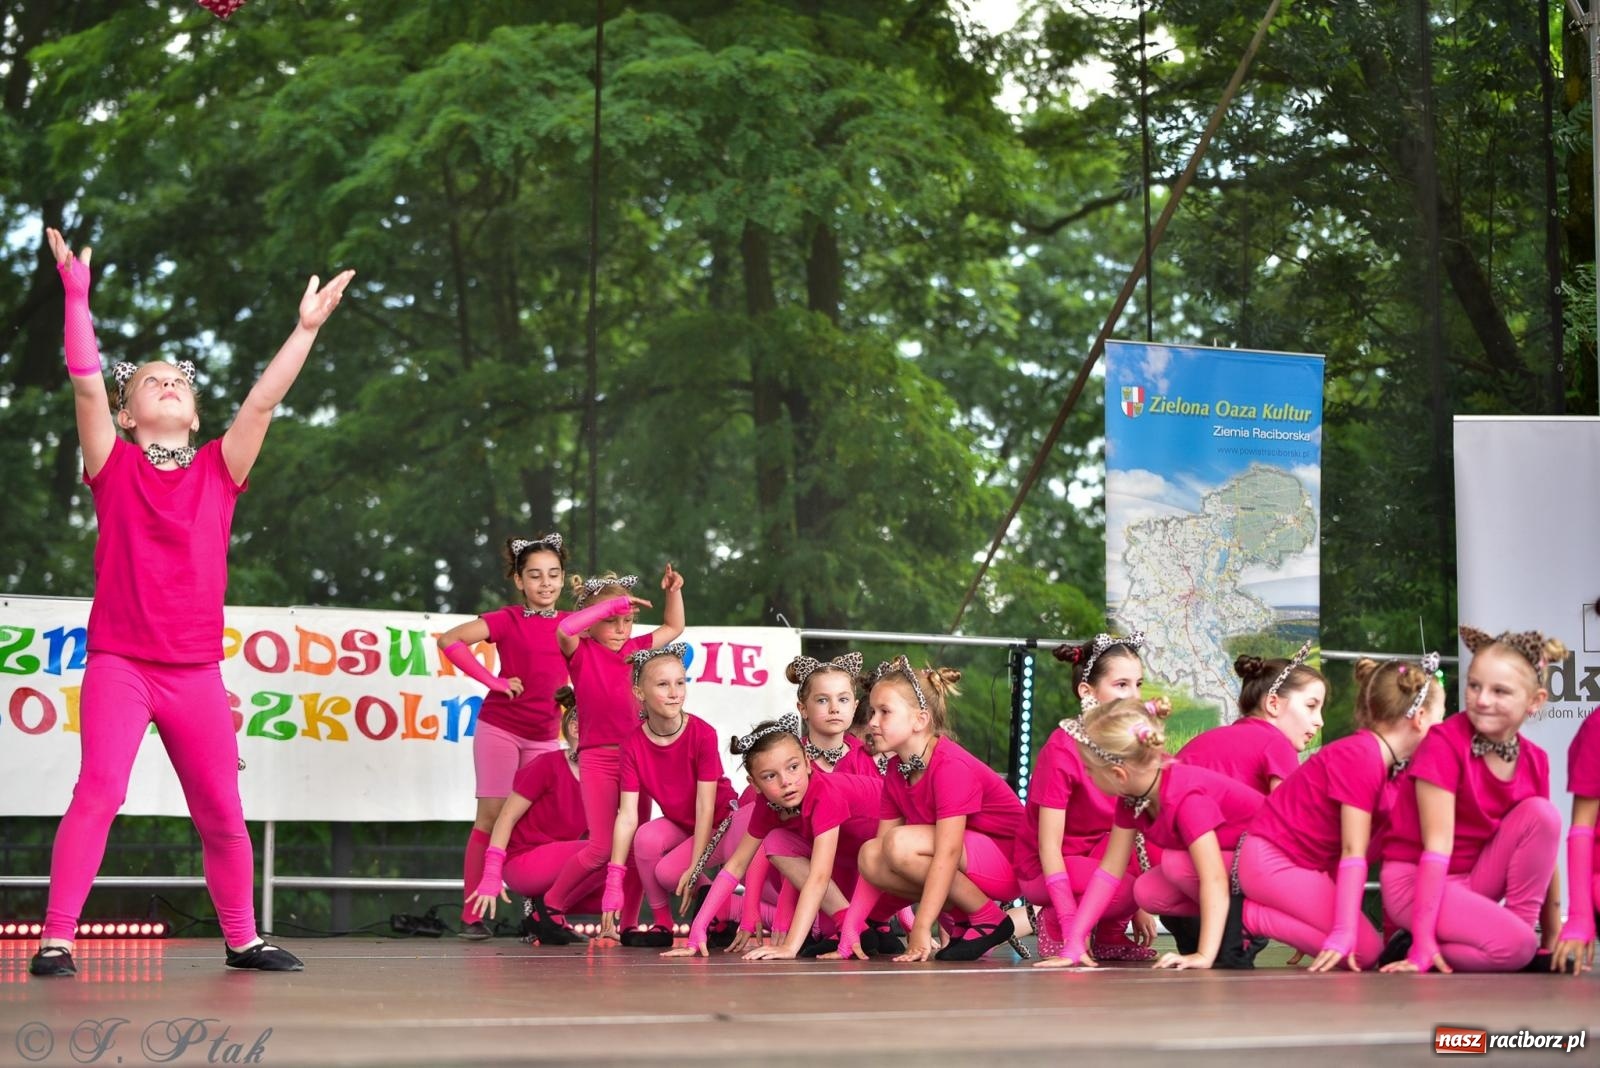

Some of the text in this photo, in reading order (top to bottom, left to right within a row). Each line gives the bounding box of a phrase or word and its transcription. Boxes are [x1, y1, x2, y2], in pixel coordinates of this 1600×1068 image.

[1149, 396, 1312, 422] Zielona Oaza Kultur
[1213, 425, 1310, 441] Ziemia Raciborska
[1546, 650, 1600, 703] dk
[1548, 706, 1573, 719] dom
